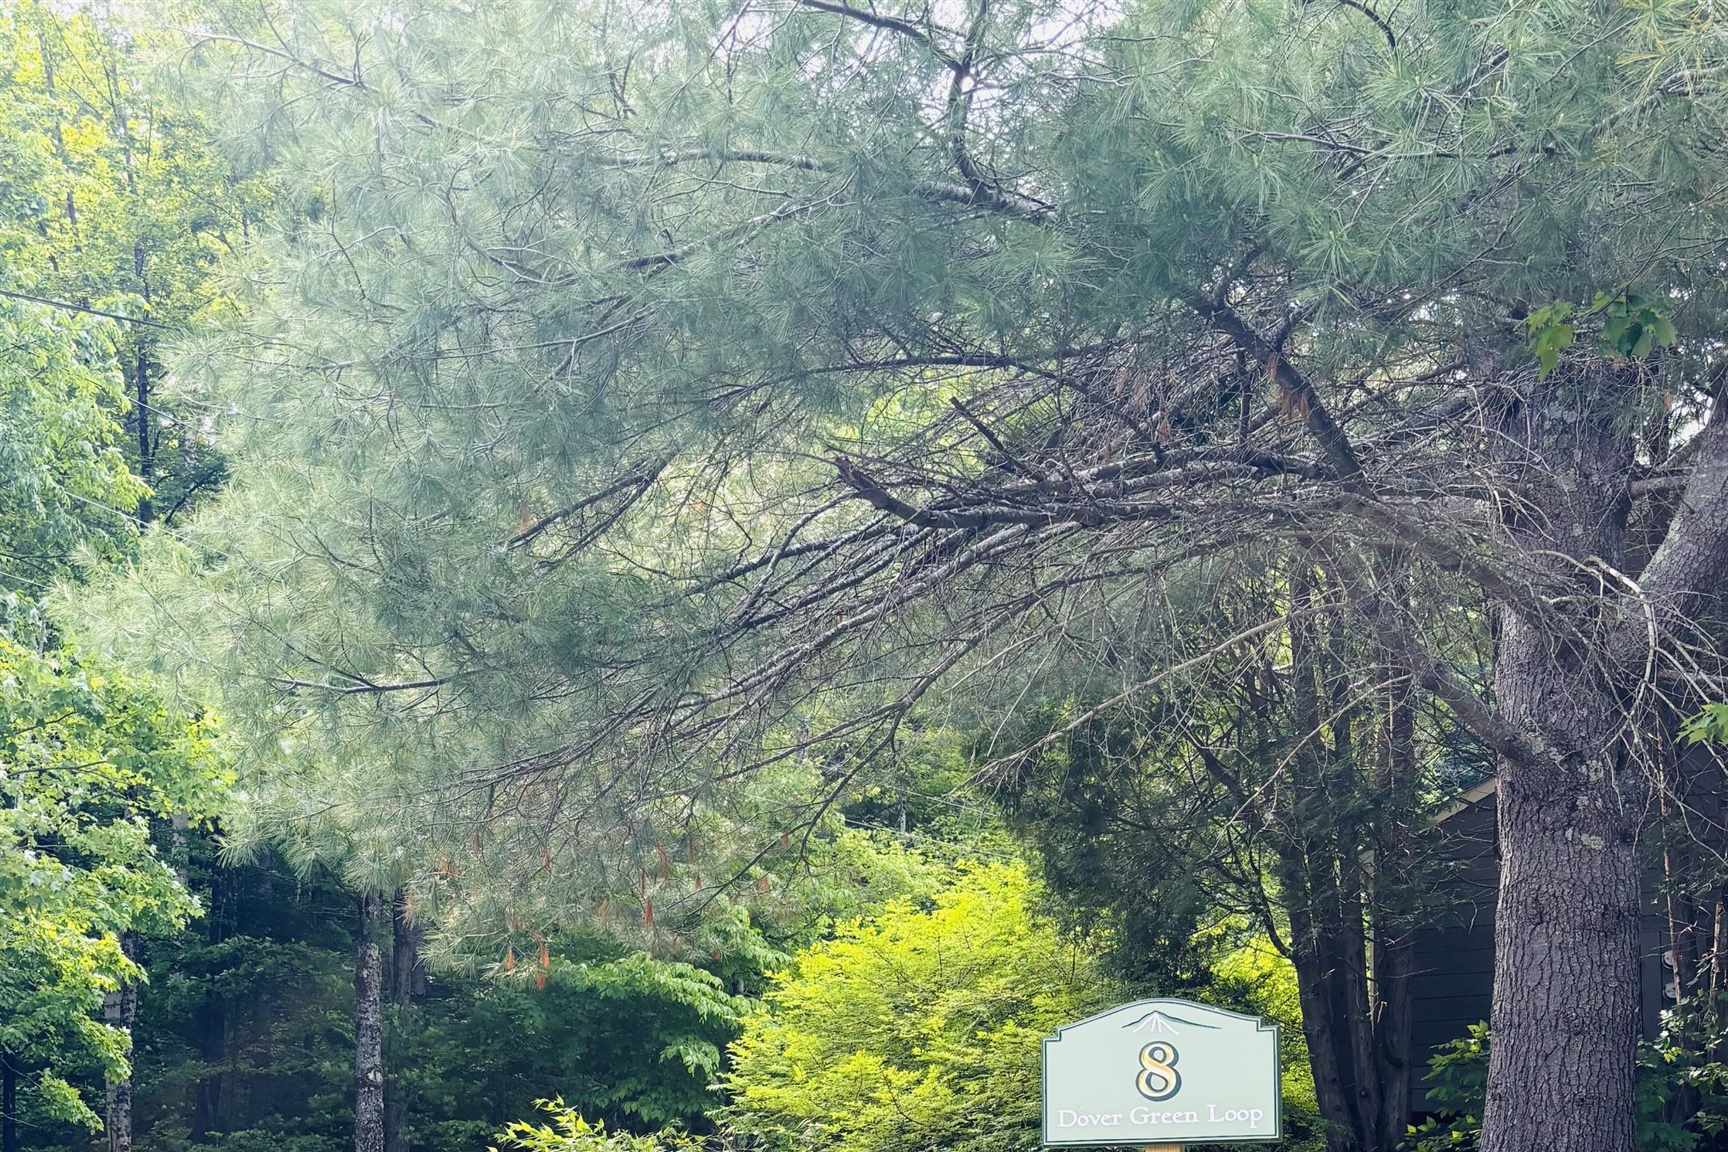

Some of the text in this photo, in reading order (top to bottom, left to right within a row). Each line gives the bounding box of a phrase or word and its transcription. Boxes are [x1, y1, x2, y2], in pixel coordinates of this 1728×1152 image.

[1136, 1041, 1182, 1102] 8
[1057, 1104, 1263, 1128] Dover Green Loop
